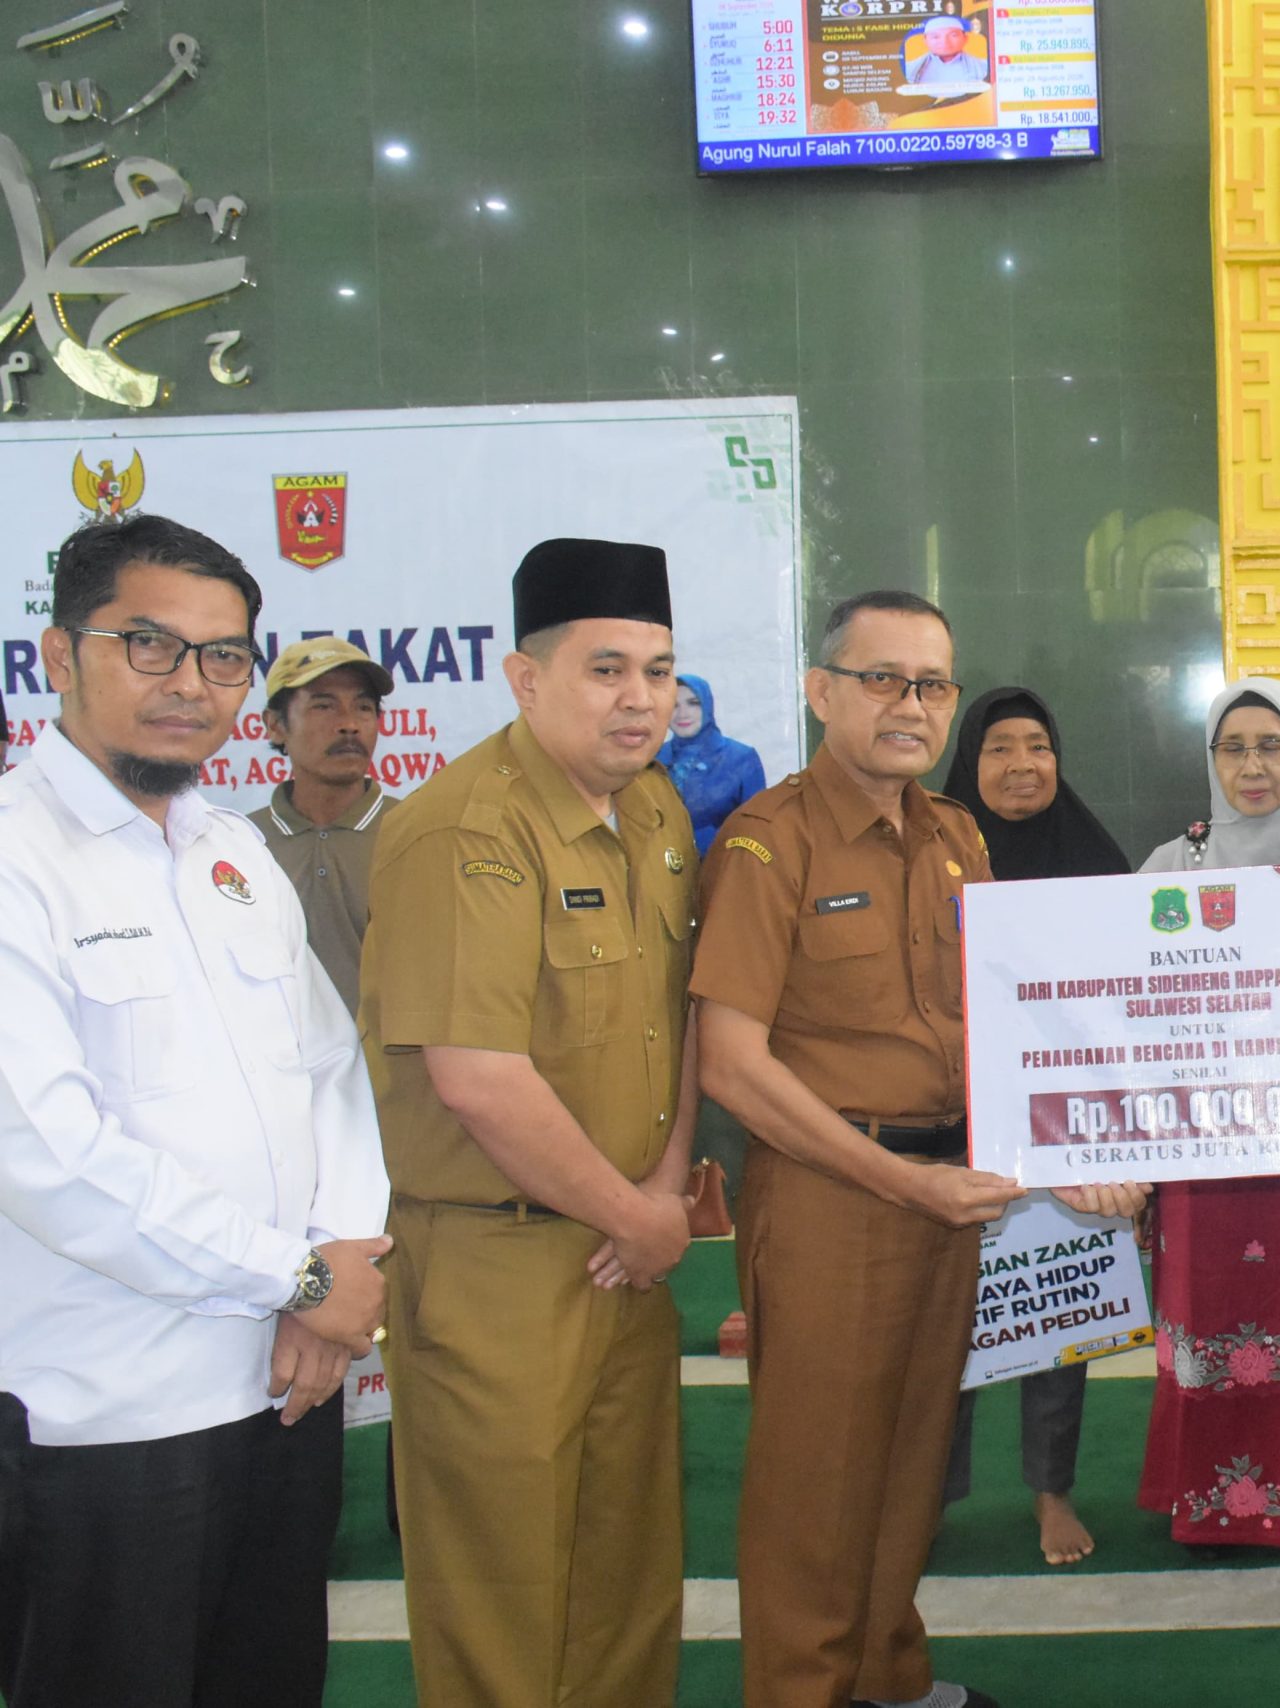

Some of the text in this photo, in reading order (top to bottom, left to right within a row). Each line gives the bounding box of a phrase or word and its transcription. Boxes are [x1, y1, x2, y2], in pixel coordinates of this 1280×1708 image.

[763, 20, 793, 34] 5:00
[764, 38, 793, 52] 6:11
[1020, 40, 1034, 52] Rp.
[756, 56, 794, 71] 12:21
[757, 74, 795, 89] 15:30
[757, 92, 796, 107] 18:24
[1023, 86, 1036, 98] Rp.
[758, 110, 797, 125] 19:32
[1020, 113, 1035, 126] Rp.
[702, 131, 1028, 165] Agung Nurul Falah 7100.0220.59798-3 B
[283, 475, 338, 487] AGAM
[1149, 945, 1242, 967] BANTUAN
[1017, 981, 1052, 1002] DARI
[1056, 976, 1143, 999] KABUPATEN
[1148, 971, 1231, 995] SIDENRENG
[1126, 991, 1273, 1019] SULAWESI SELATAN
[1169, 1022, 1226, 1037] UNTUK
[1022, 1046, 1126, 1069] PENANGANAN
[1132, 1042, 1206, 1063] BENCANA
[1211, 1040, 1228, 1059] DI
[1172, 1065, 1228, 1080] SENILAI
[1081, 1143, 1184, 1165] SERATUS
[1192, 1140, 1249, 1158] JUTA
[1034, 1228, 1117, 1264] ZAKAT
[1036, 1254, 1116, 1290] HIDUP
[1011, 1281, 1100, 1317] RUTIN)
[1041, 1297, 1131, 1335] PEDULI
